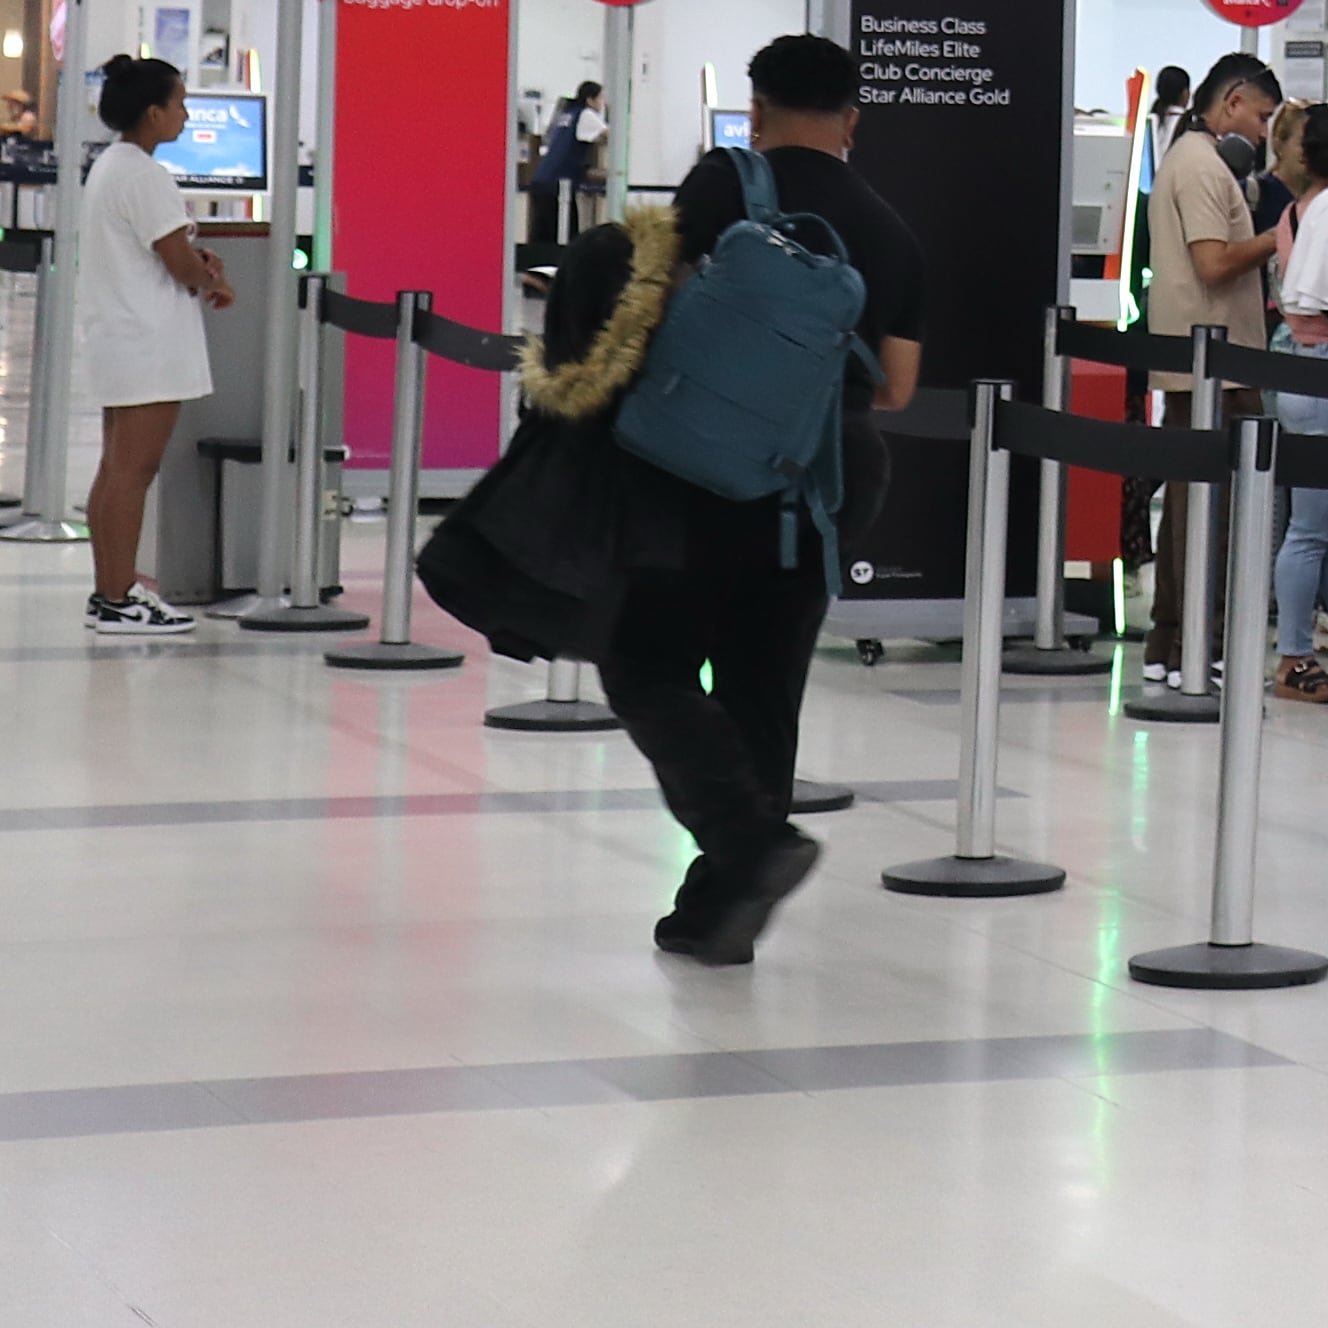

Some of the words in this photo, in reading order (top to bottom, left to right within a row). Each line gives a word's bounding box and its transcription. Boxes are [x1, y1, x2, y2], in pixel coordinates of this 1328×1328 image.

[860, 15, 938, 34] Business
[941, 16, 987, 35] Class
[860, 40, 940, 58] LifeMiles
[943, 41, 981, 58] Elite
[859, 63, 901, 80] Club
[905, 63, 994, 85] Concierge
[859, 86, 895, 103] Star
[899, 86, 966, 104] Alliance
[969, 88, 1010, 105] Gold
